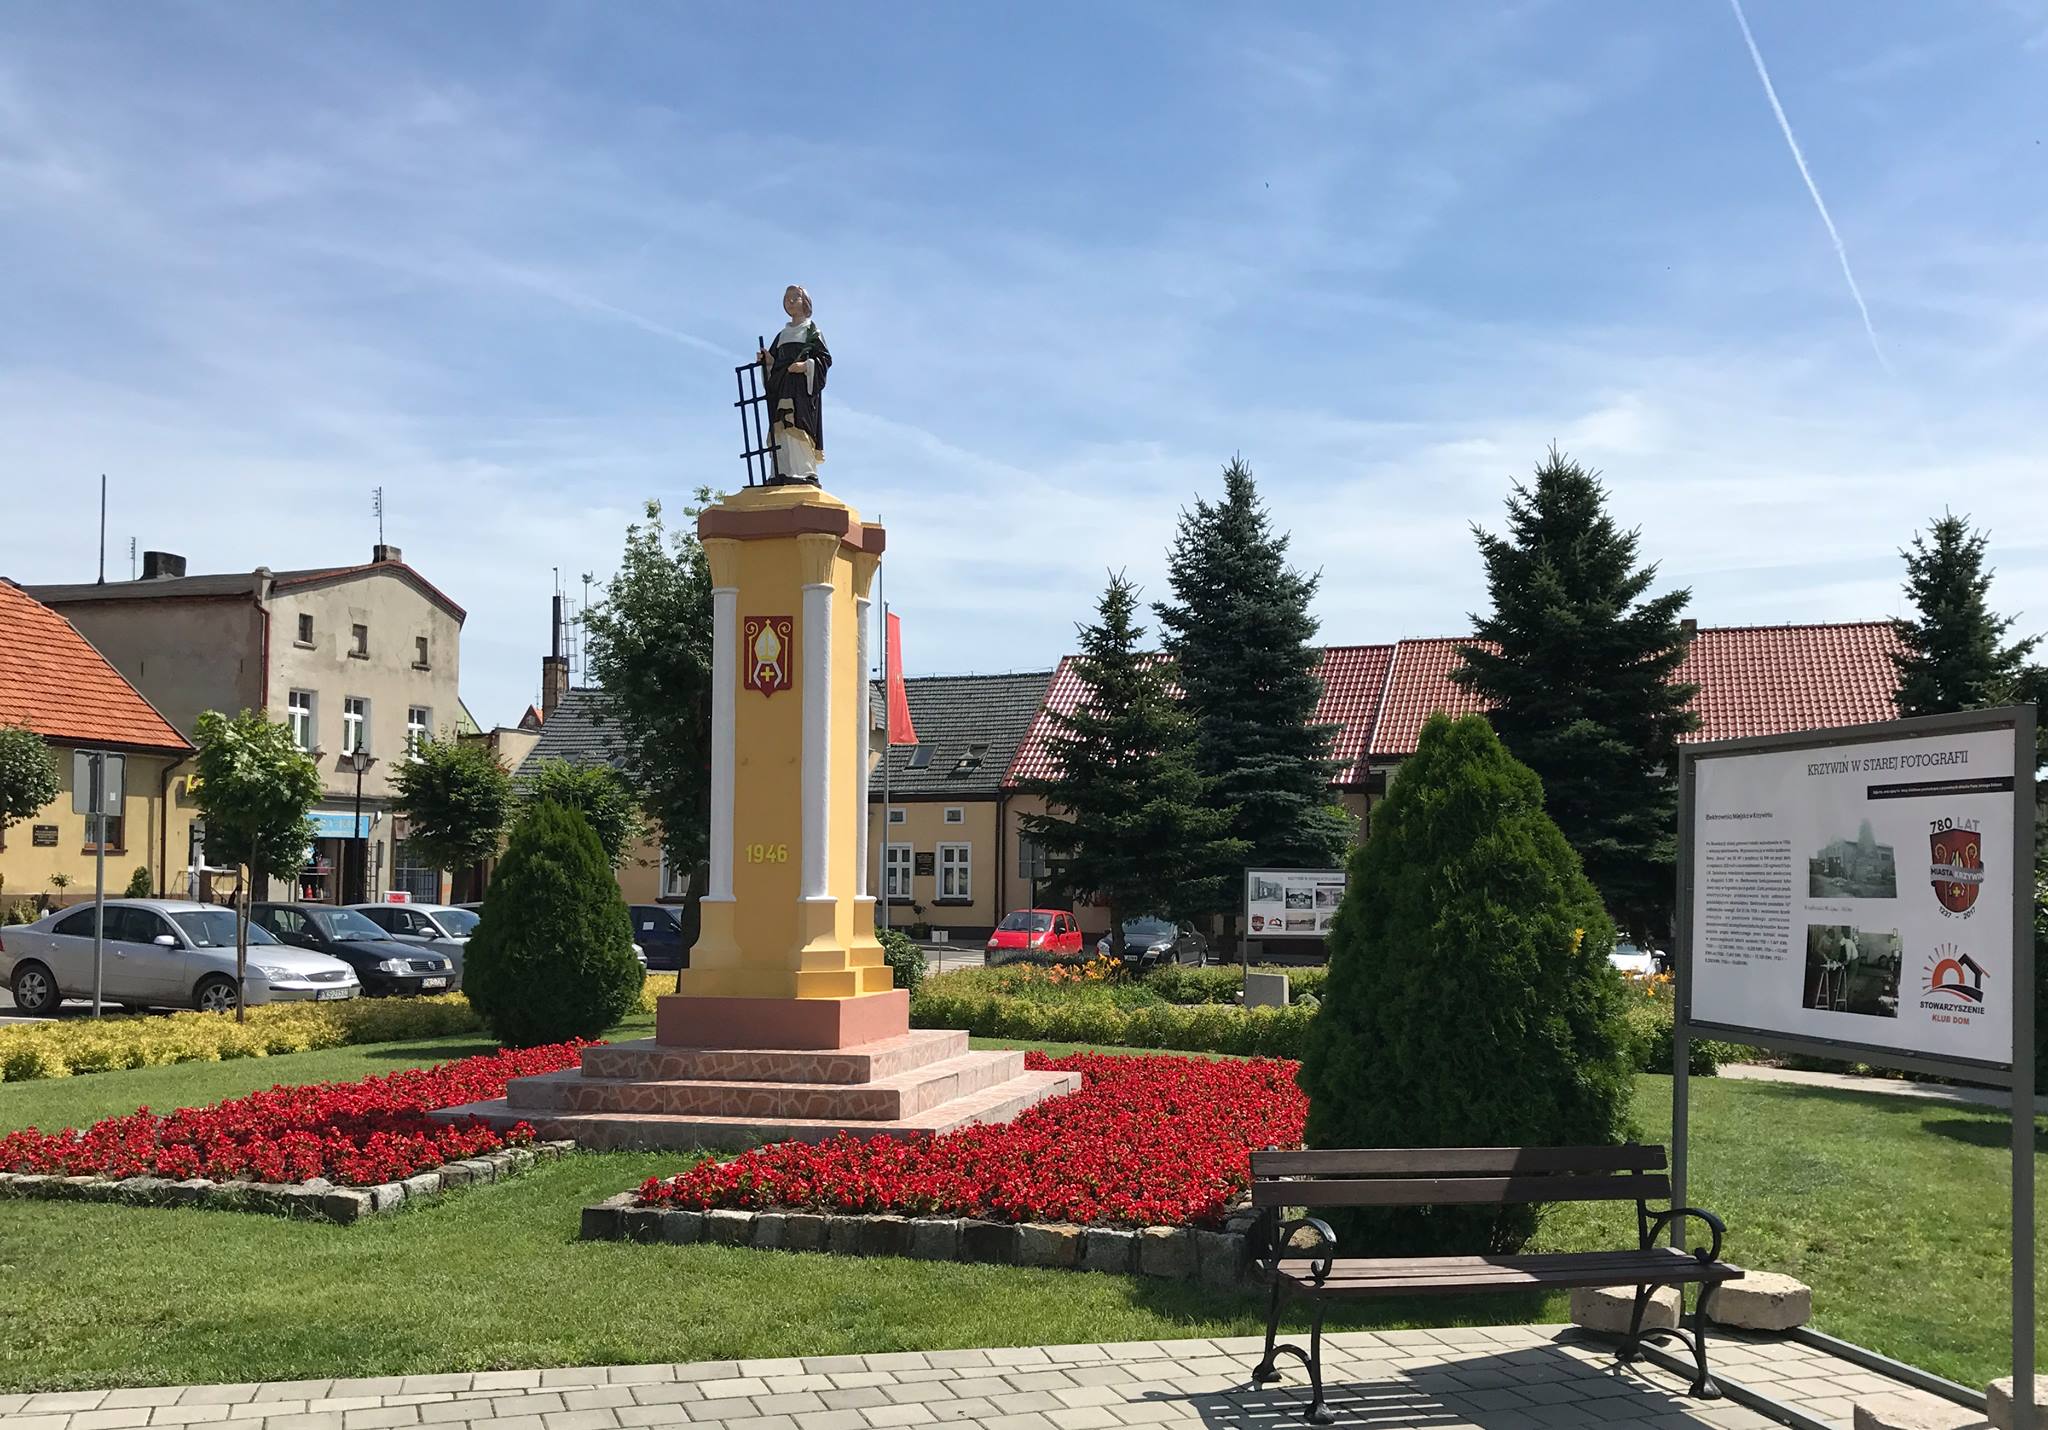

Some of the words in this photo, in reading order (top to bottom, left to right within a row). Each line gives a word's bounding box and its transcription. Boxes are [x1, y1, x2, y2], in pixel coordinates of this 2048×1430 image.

[1851, 759, 1862, 772] W
[1863, 756, 1898, 771] STAREJ
[1900, 750, 1969, 768] FOTOGRAFII
[1929, 817, 1953, 834] 780
[1957, 816, 1980, 832] LAT
[745, 844, 788, 863] 1946
[1919, 1001, 1985, 1015] STOWARZYSZENIE
[1931, 1014, 1951, 1024] KLUB
[1952, 1016, 1970, 1026] DOM
